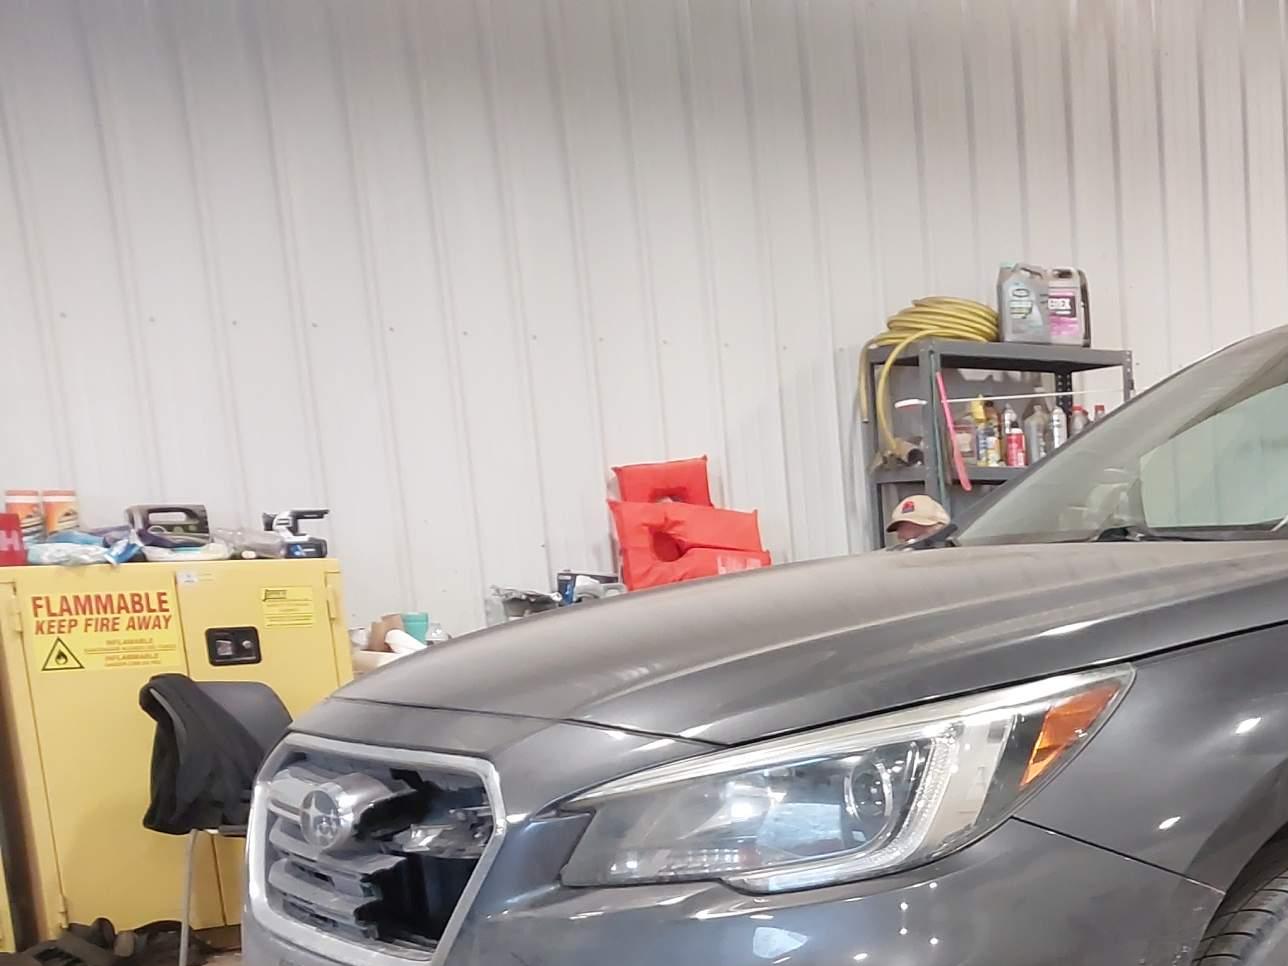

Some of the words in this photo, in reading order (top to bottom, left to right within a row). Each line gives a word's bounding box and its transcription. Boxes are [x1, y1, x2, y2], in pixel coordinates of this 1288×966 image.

[31, 591, 170, 618] FLAMMABLE
[34, 618, 78, 635] KEEP
[83, 617, 120, 633] FIRE
[126, 615, 172, 631] AWAY
